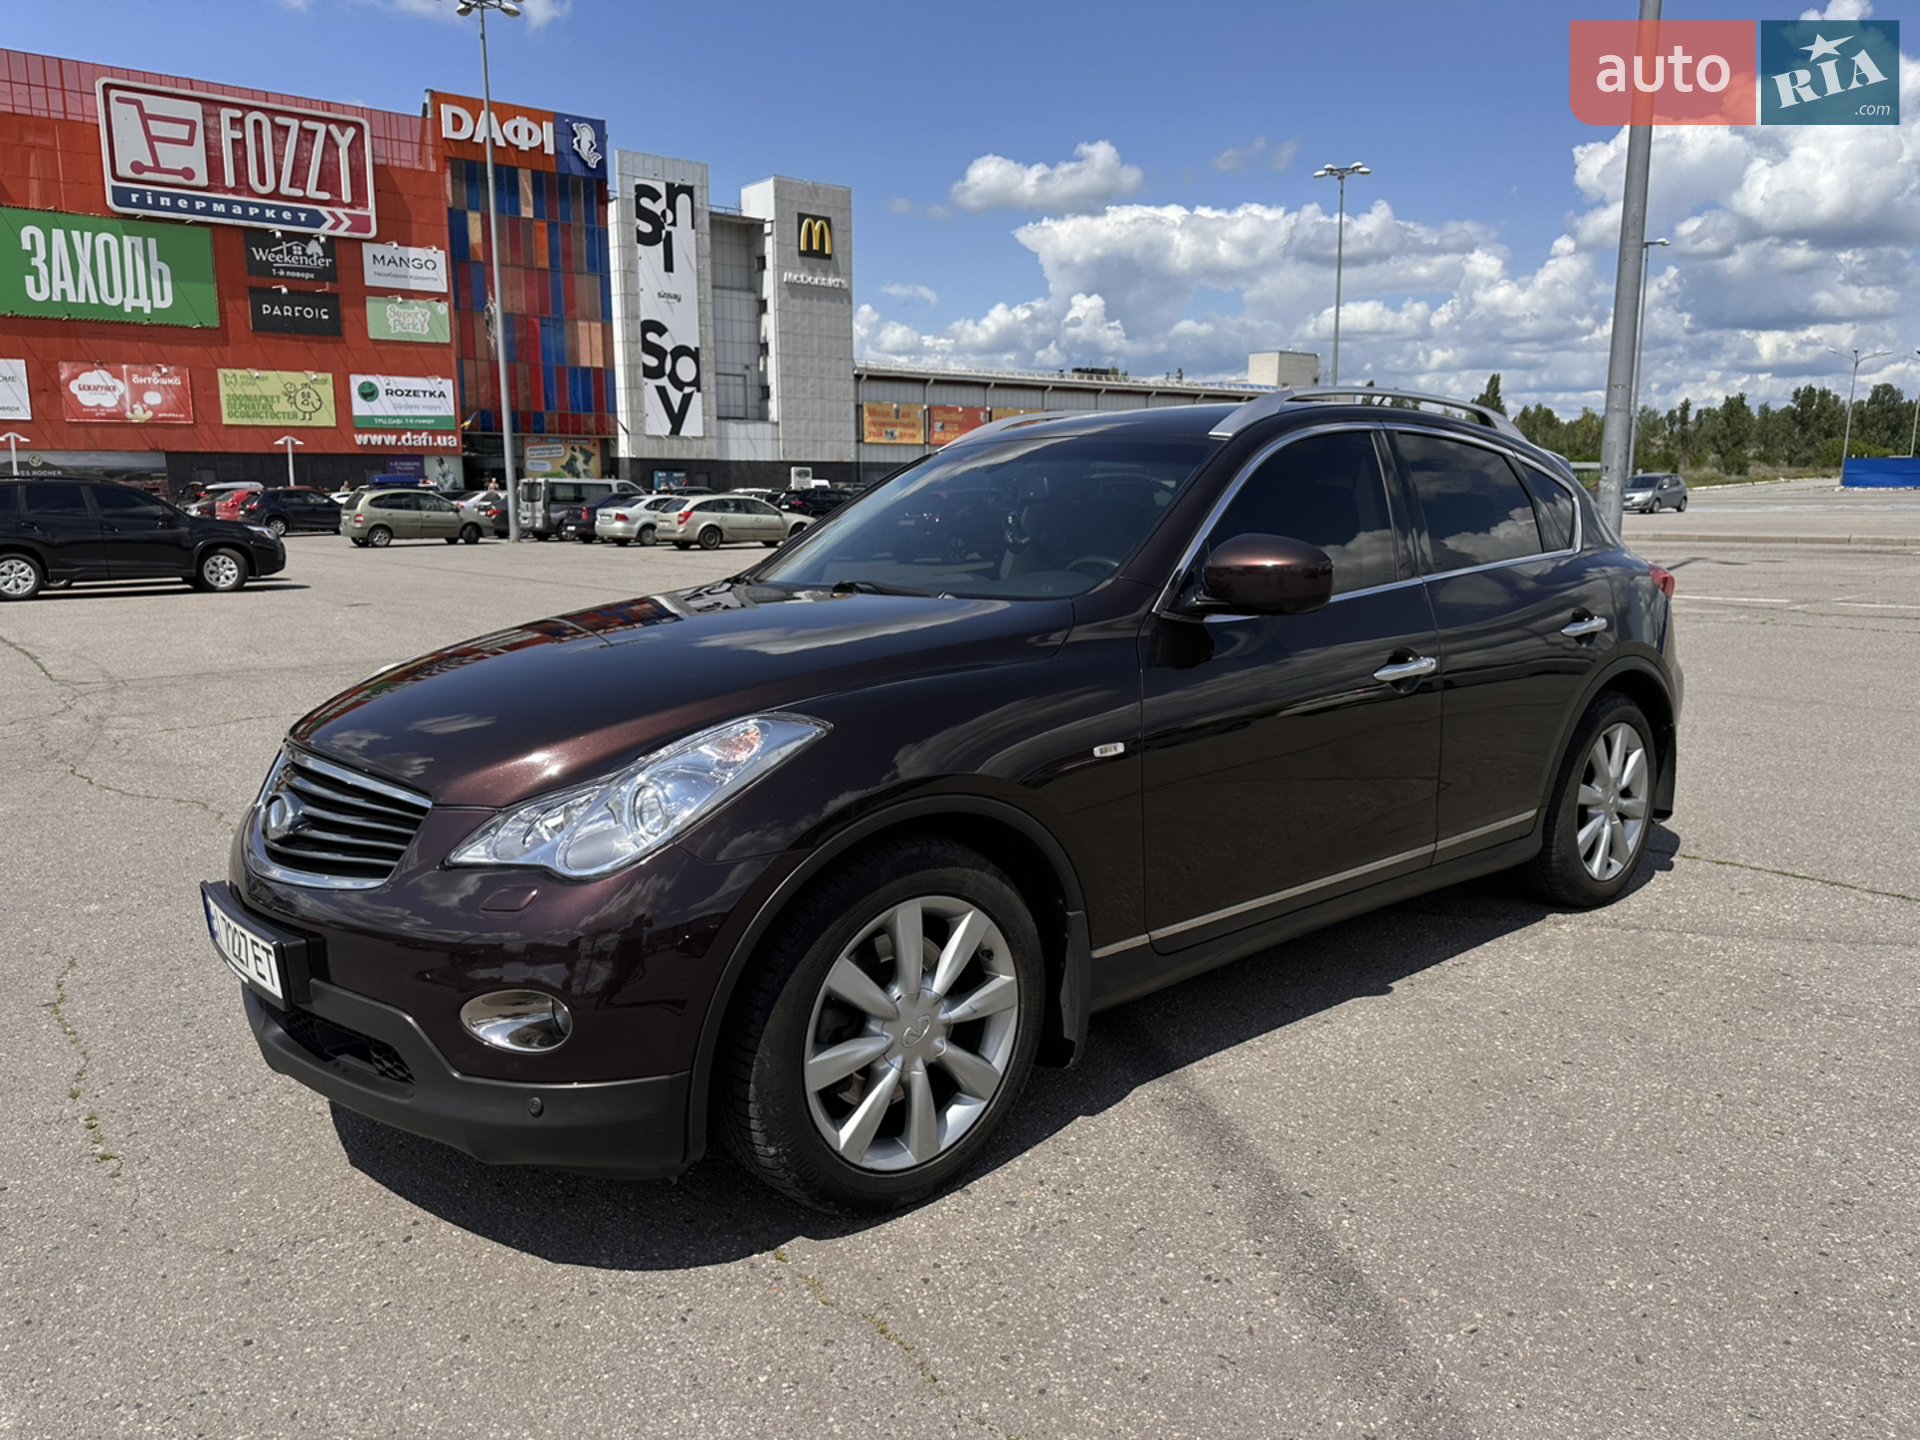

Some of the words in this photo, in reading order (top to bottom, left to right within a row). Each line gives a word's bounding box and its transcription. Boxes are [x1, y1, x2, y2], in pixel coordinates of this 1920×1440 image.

[220, 107, 356, 204] FOZZY
[130, 191, 308, 222] гіпермаркет
[250, 246, 332, 268] Weekender
[372, 253, 437, 271] MANGO
[20, 225, 174, 314] ЗАХОДЬ
[286, 271, 315, 280] поверх
[783, 271, 848, 289] McDonald's
[262, 304, 329, 319] PARFOIS
[226, 393, 281, 403] ЗООМАРКЕТ
[385, 388, 447, 399] ROZETKA
[227, 410, 299, 420] ОСОБИСТОСТЕЙ
[353, 431, 457, 447] www.dafi.ua
[250, 938, 276, 988] ET
